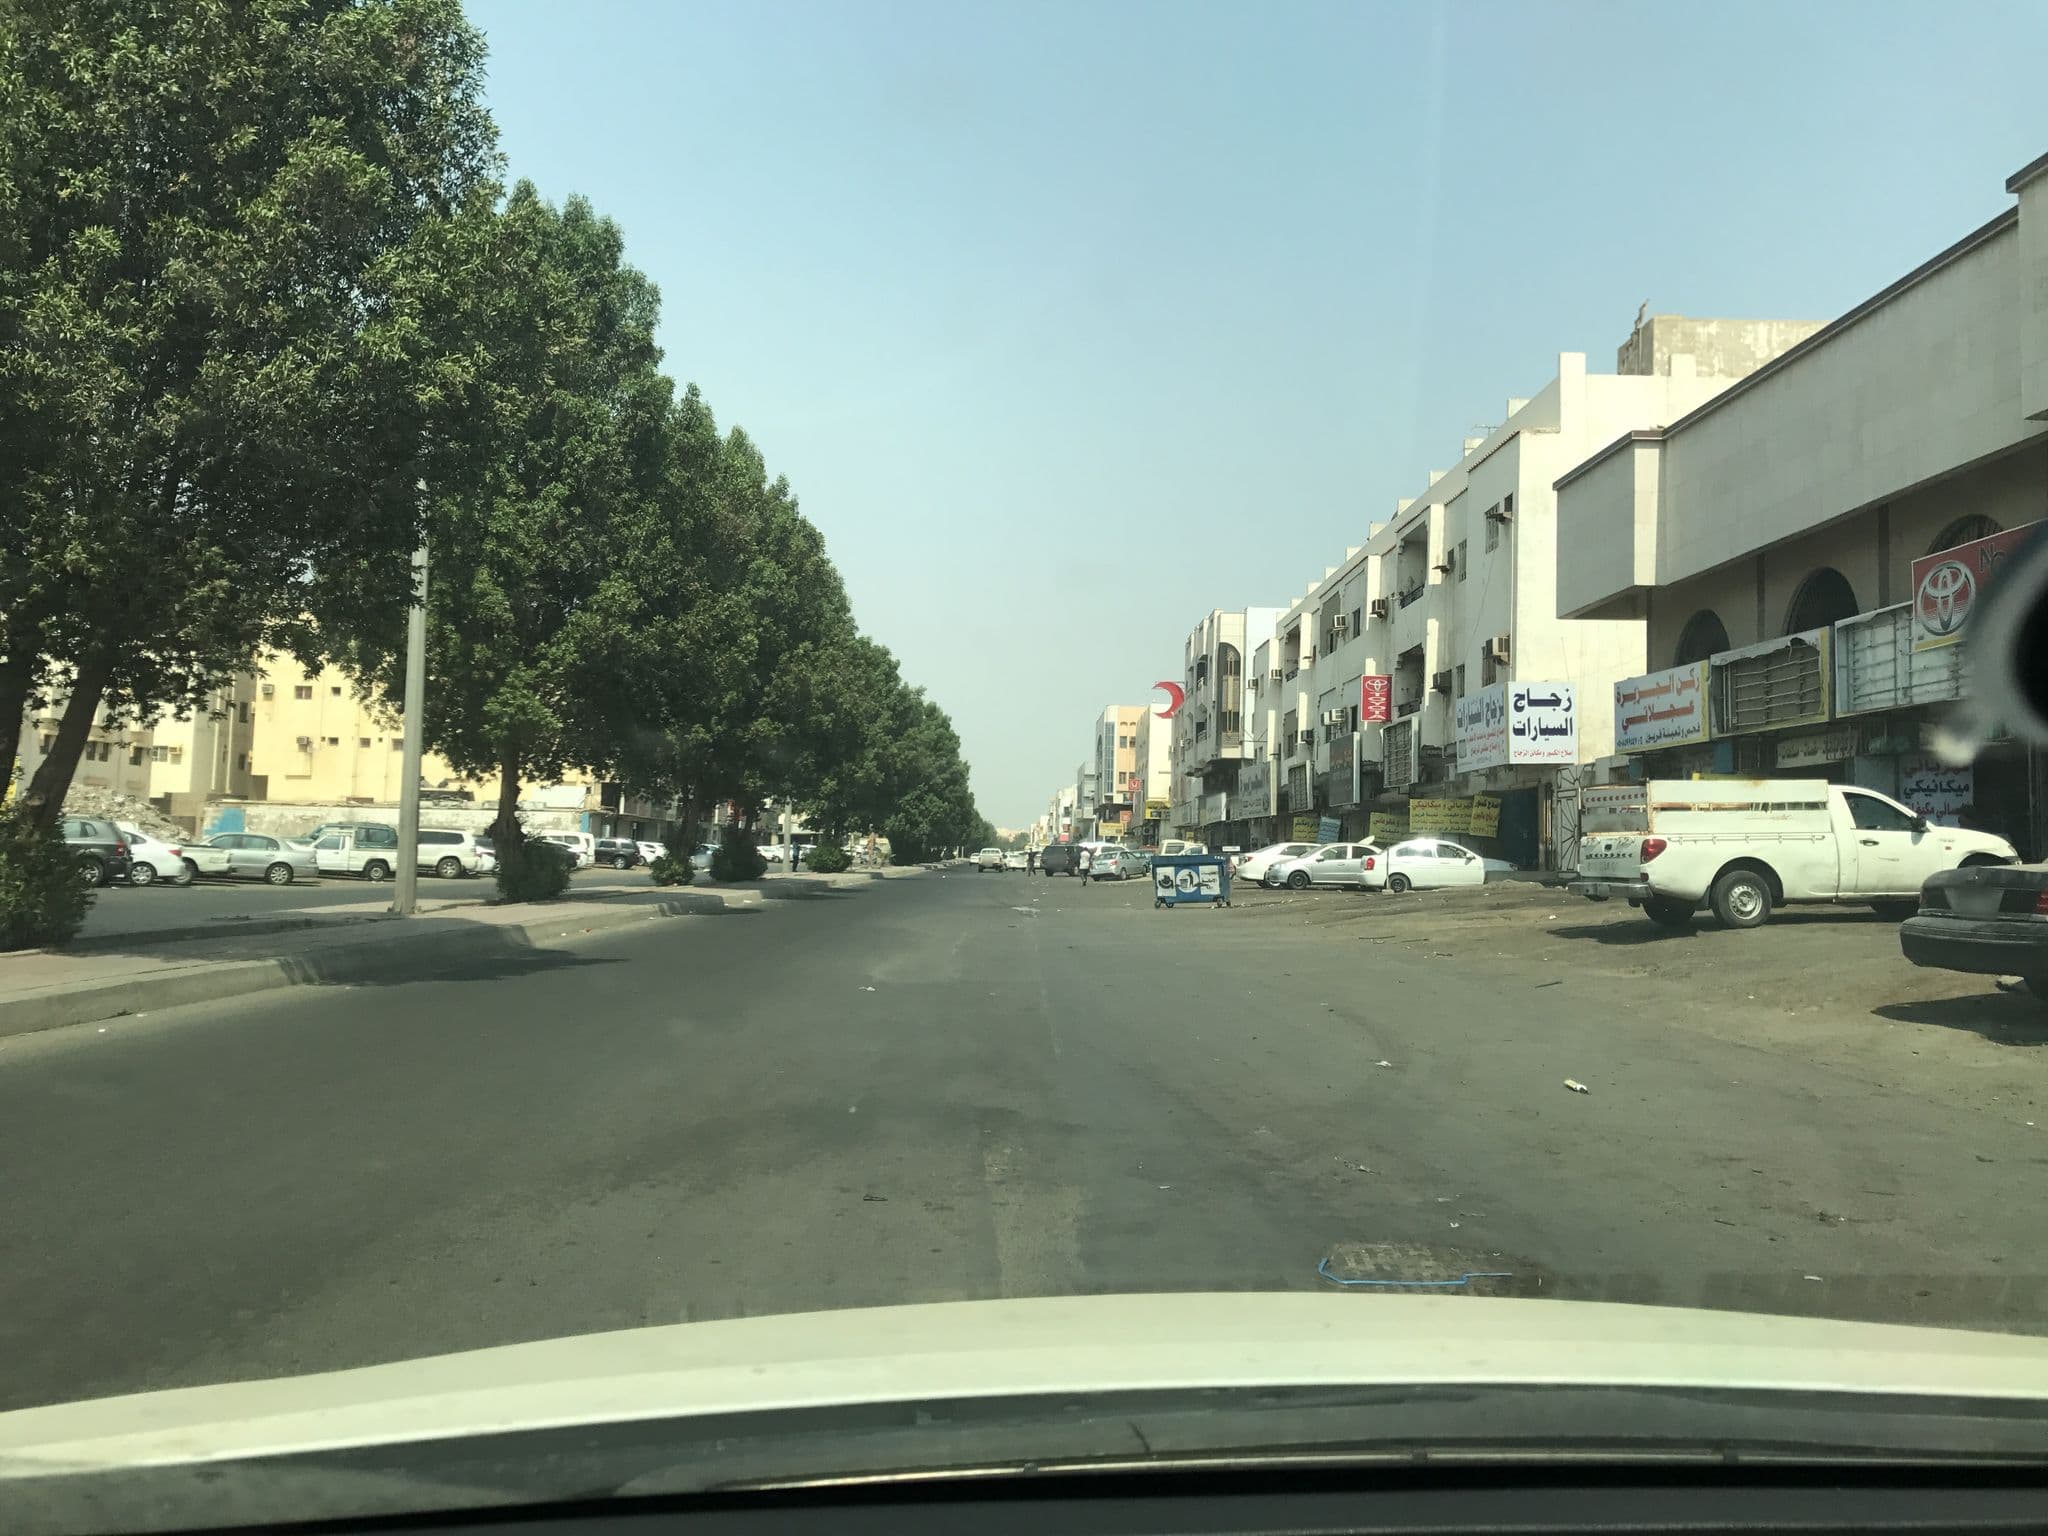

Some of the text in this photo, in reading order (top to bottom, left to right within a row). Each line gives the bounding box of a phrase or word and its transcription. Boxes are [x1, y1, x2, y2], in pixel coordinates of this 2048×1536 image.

[1367, 691, 1387, 720] TOYOTA
[1513, 688, 1572, 713] زجاج
[1512, 717, 1573, 742] السيارات
[1903, 779, 1970, 799] ميكانيكي
